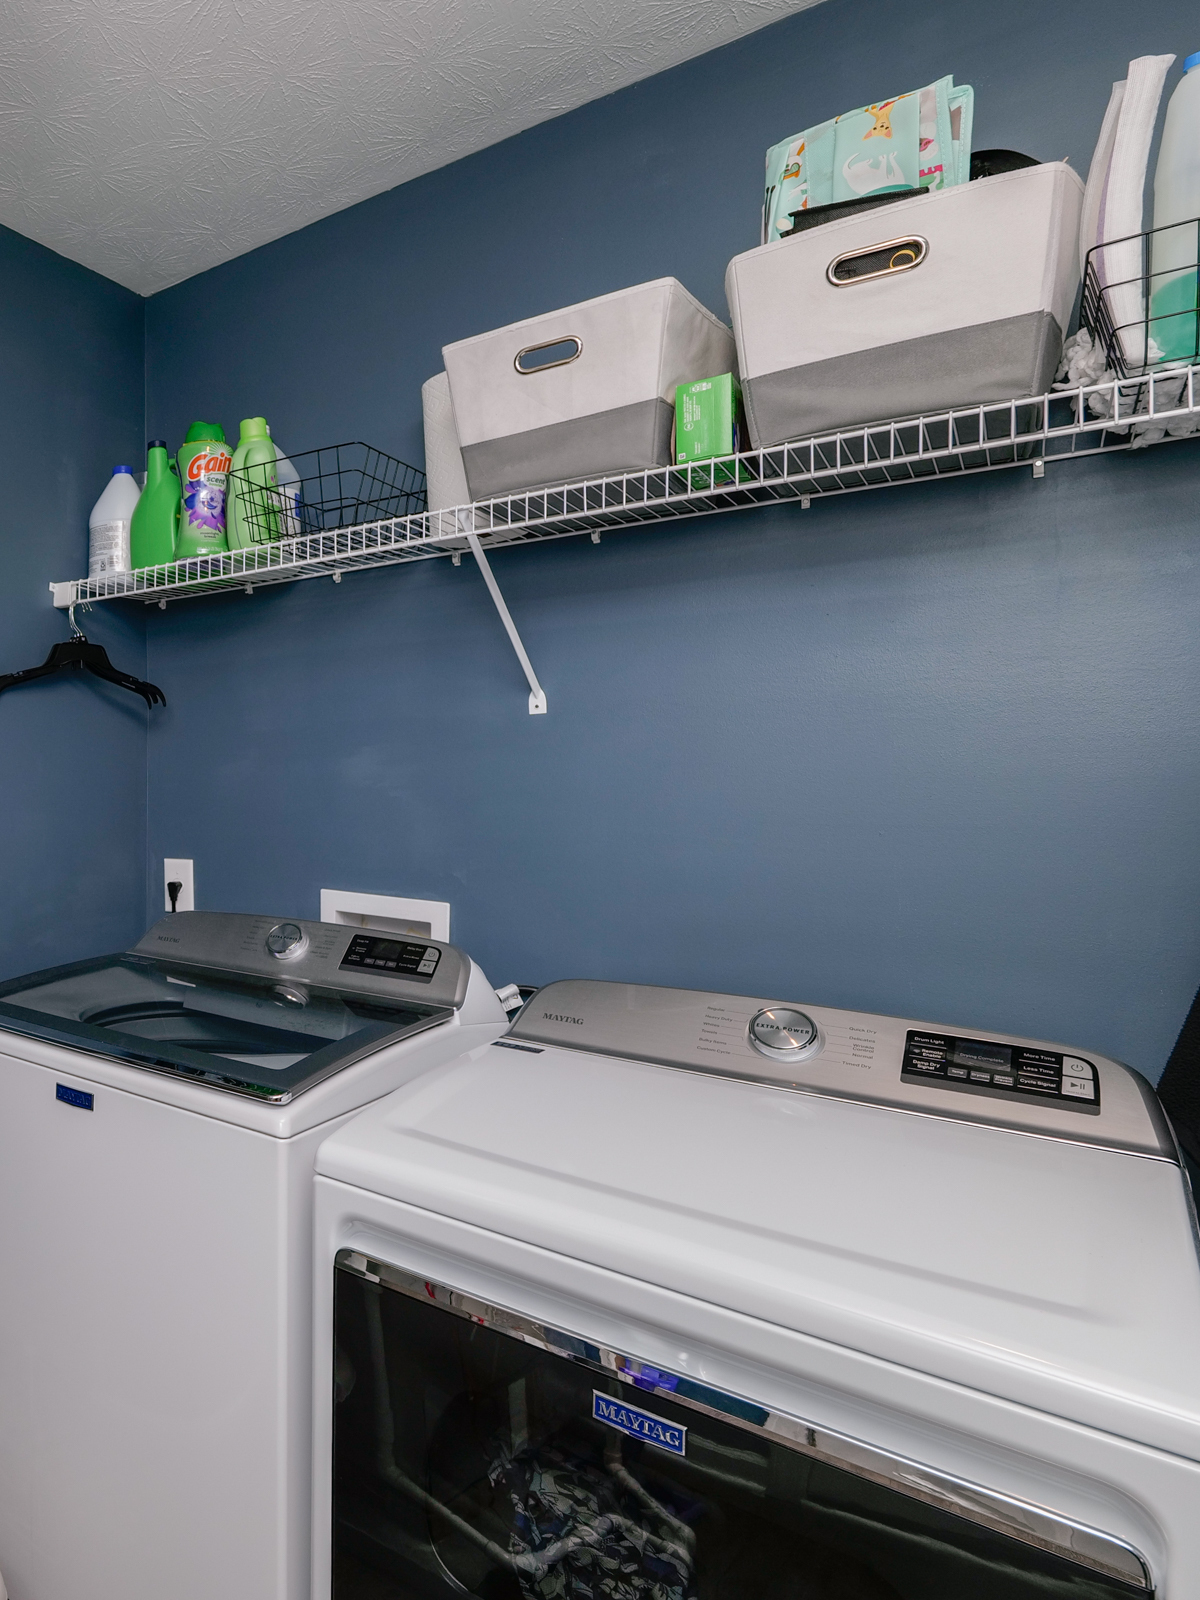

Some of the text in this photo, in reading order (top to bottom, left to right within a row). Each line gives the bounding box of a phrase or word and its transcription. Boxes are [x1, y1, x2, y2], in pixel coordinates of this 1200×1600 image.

[188, 452, 232, 480] Gain
[206, 476, 226, 485] scent
[542, 1012, 584, 1025] MAYTAG
[756, 1022, 810, 1035] EXTRA POWER
[851, 1052, 873, 1060] Normal
[921, 1048, 943, 1056] Remote
[1023, 1052, 1037, 1060] More
[912, 1059, 927, 1067] Damp
[959, 1052, 1004, 1064] Drying Complete
[917, 1063, 935, 1072] Signal
[1019, 1078, 1057, 1089] Cycle Signal
[598, 1400, 680, 1447] MAYTAG
